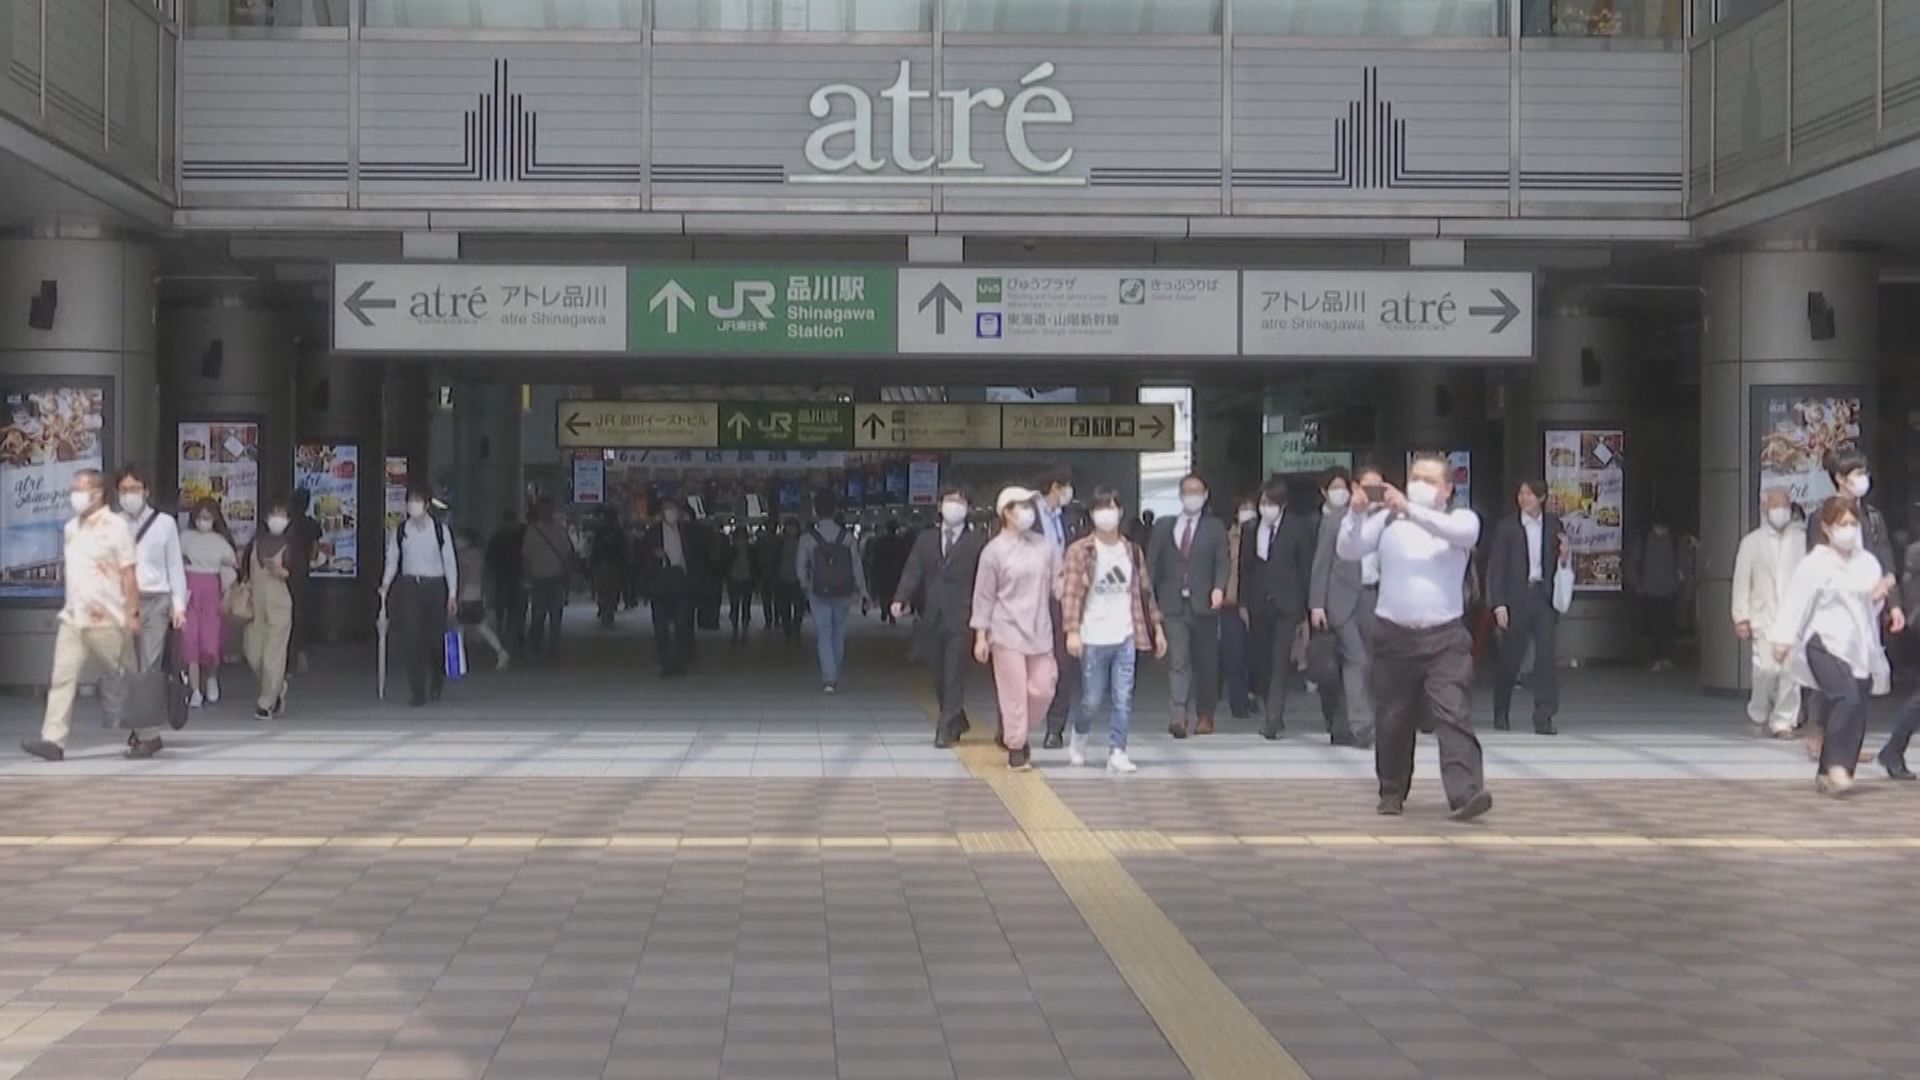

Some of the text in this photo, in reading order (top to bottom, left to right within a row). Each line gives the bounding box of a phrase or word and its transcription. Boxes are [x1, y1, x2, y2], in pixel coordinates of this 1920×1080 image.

[804, 59, 1074, 173] atré
[501, 285, 607, 308] アトレ品川
[787, 276, 865, 301] 品川駅
[409, 283, 487, 319] atré
[708, 281, 776, 319] JR
[1261, 290, 1366, 313] アトレ品川
[1379, 290, 1457, 325] atré
[501, 311, 607, 328] atre Shinagawa
[787, 306, 875, 323] Shinagawa
[1261, 316, 1366, 333] atre Shinagawa
[717, 320, 768, 332] JR東日本
[787, 324, 844, 339] Station
[595, 414, 615, 426] JR
[757, 411, 793, 432] JR
